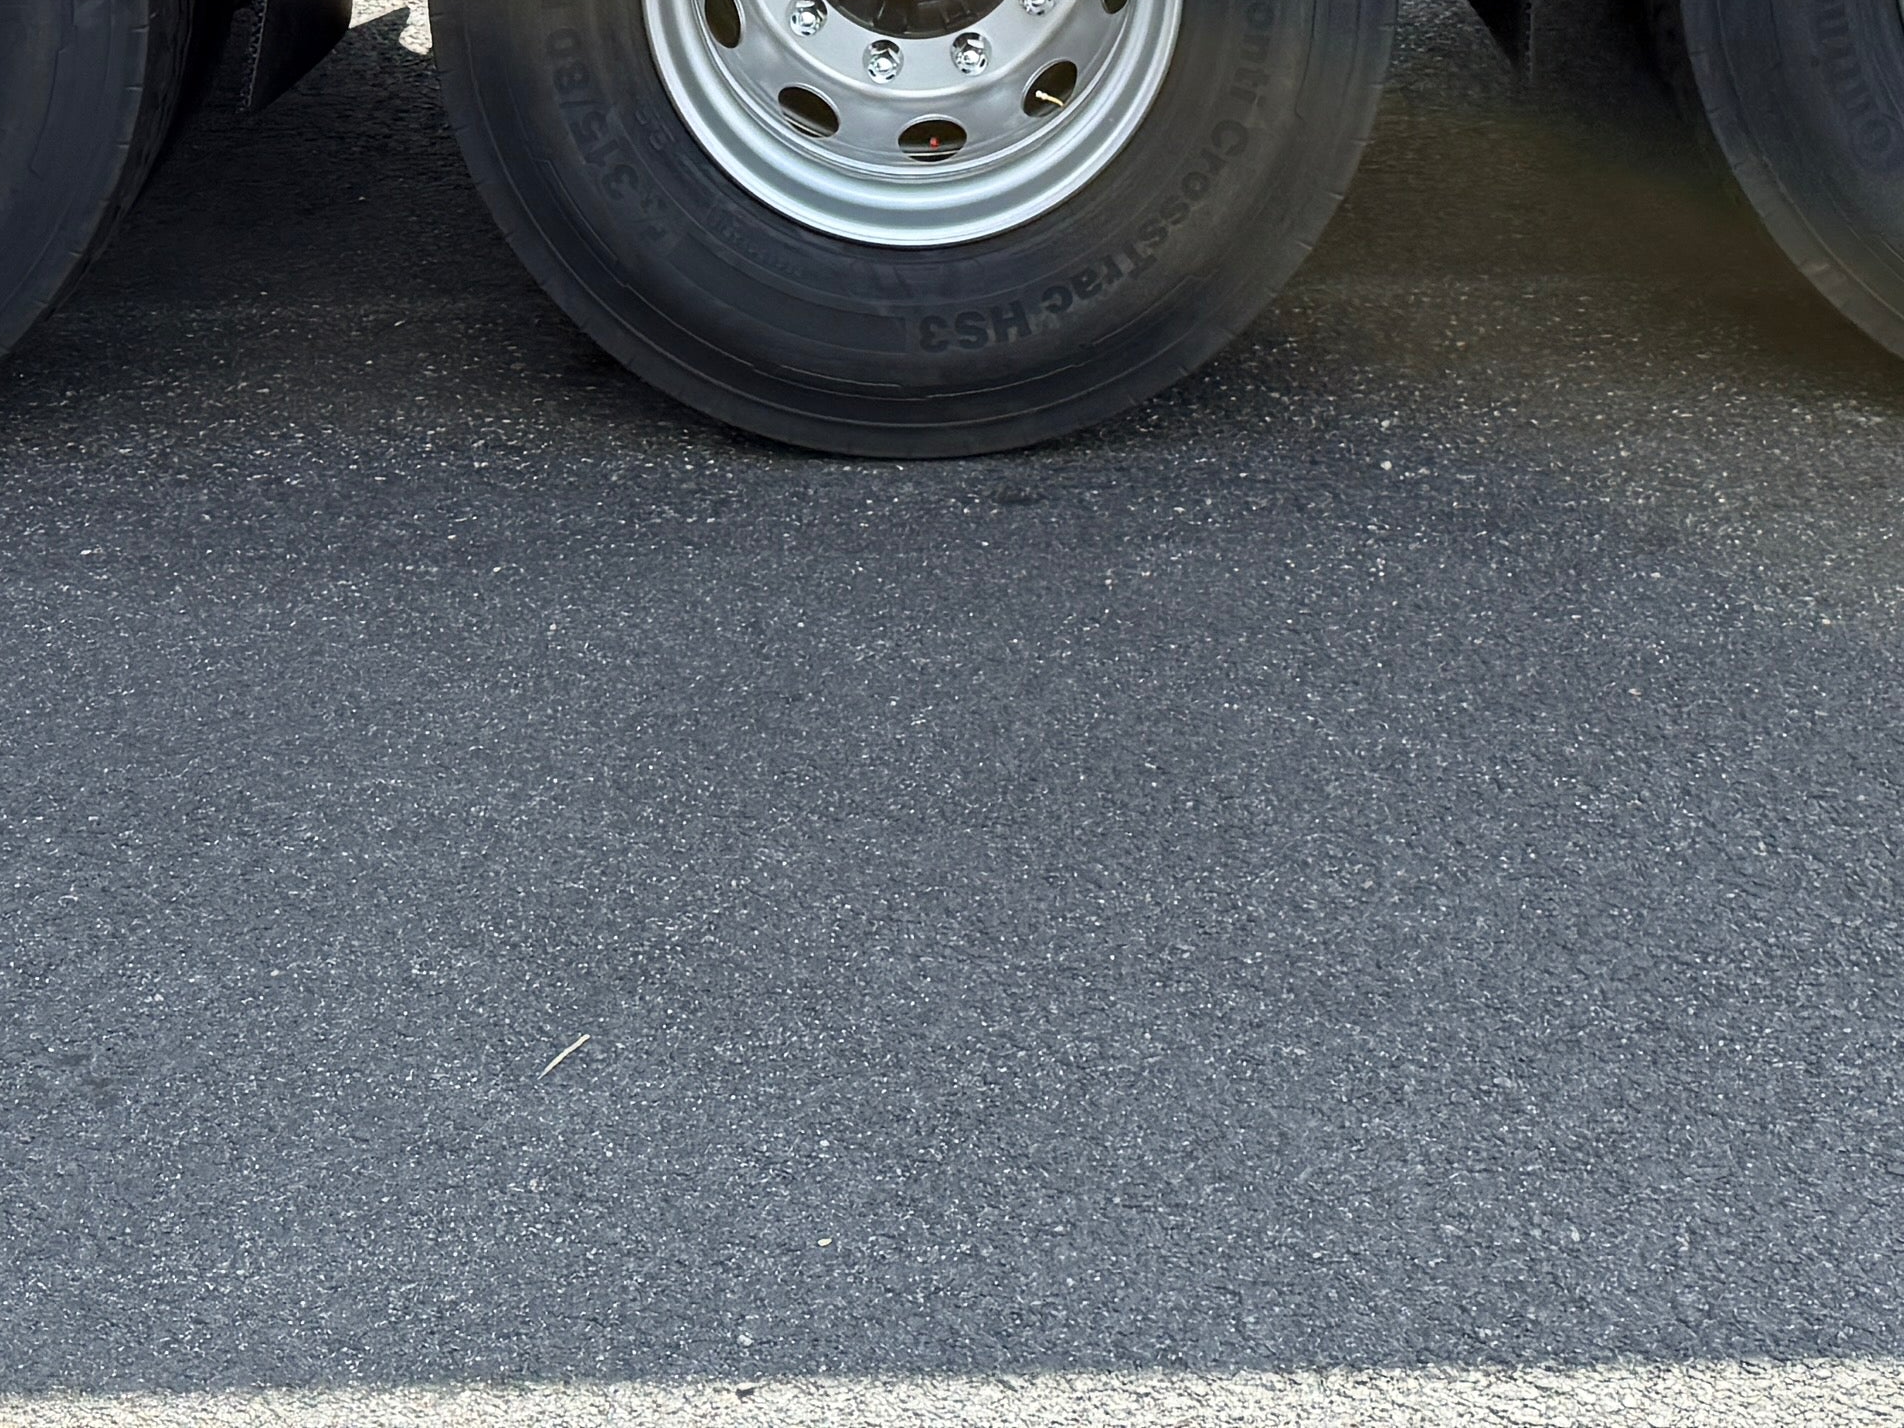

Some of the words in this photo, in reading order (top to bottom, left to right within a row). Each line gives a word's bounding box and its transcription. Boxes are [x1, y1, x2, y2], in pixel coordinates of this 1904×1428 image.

[545, 28, 638, 201] 315/80
[1041, 118, 1249, 314] CrossTrac
[919, 302, 1032, 354] HS3
